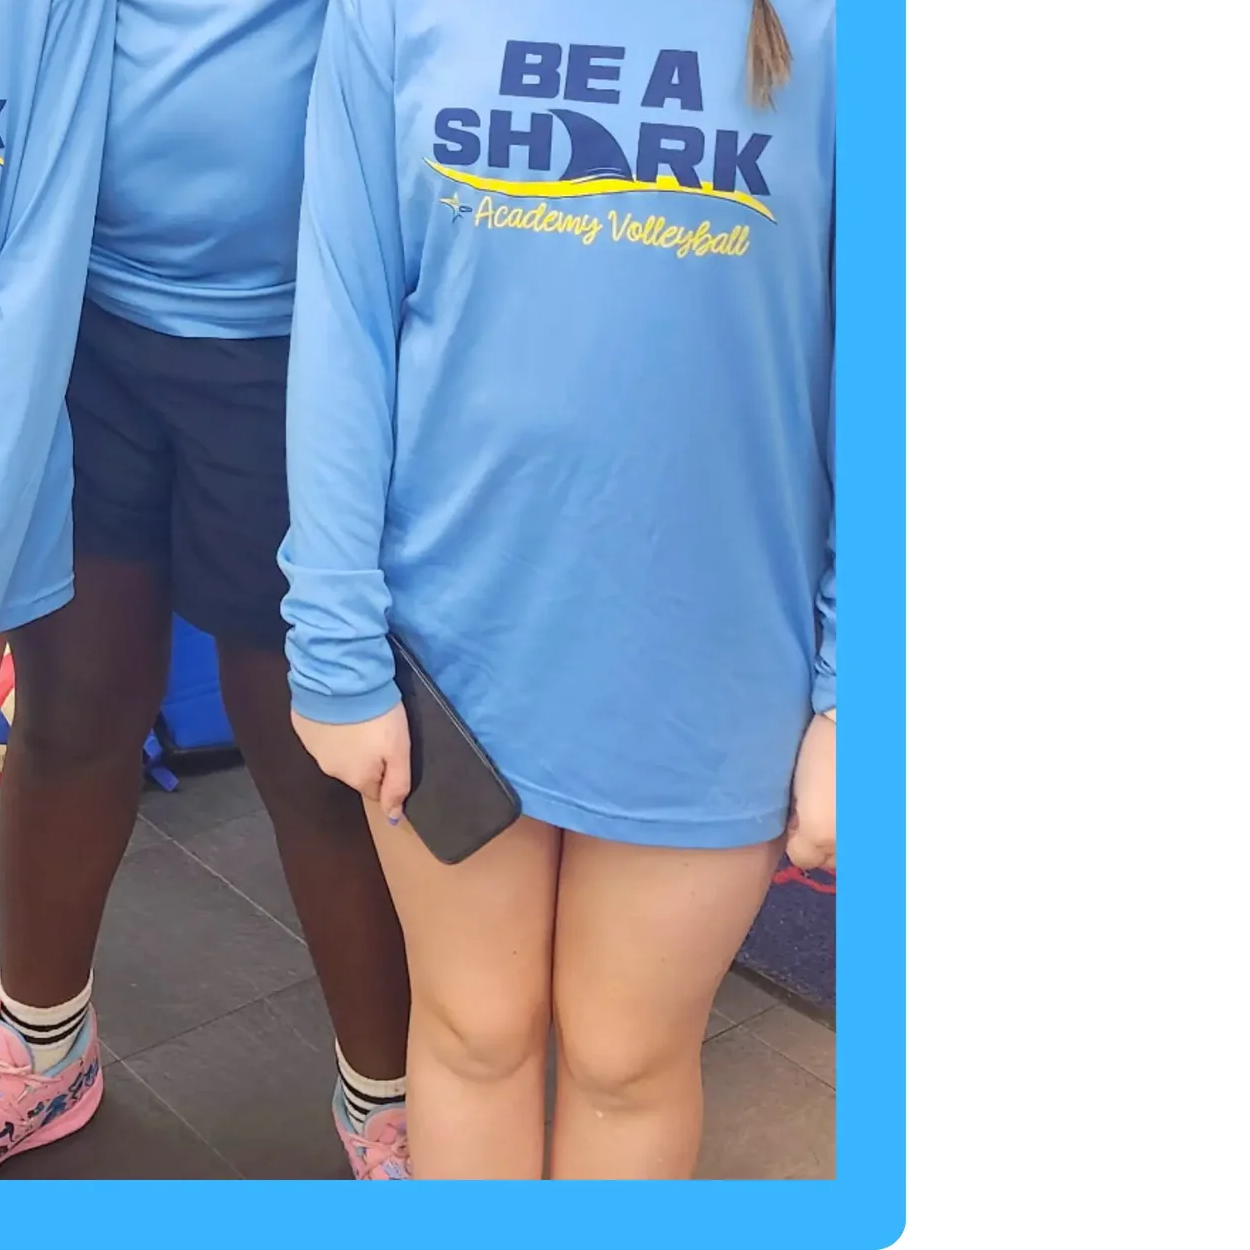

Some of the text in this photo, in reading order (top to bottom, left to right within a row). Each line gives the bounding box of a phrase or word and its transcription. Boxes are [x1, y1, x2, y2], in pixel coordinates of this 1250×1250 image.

[499, 40, 704, 112] BE A
[474, 195, 750, 259] Academy Volleyball
